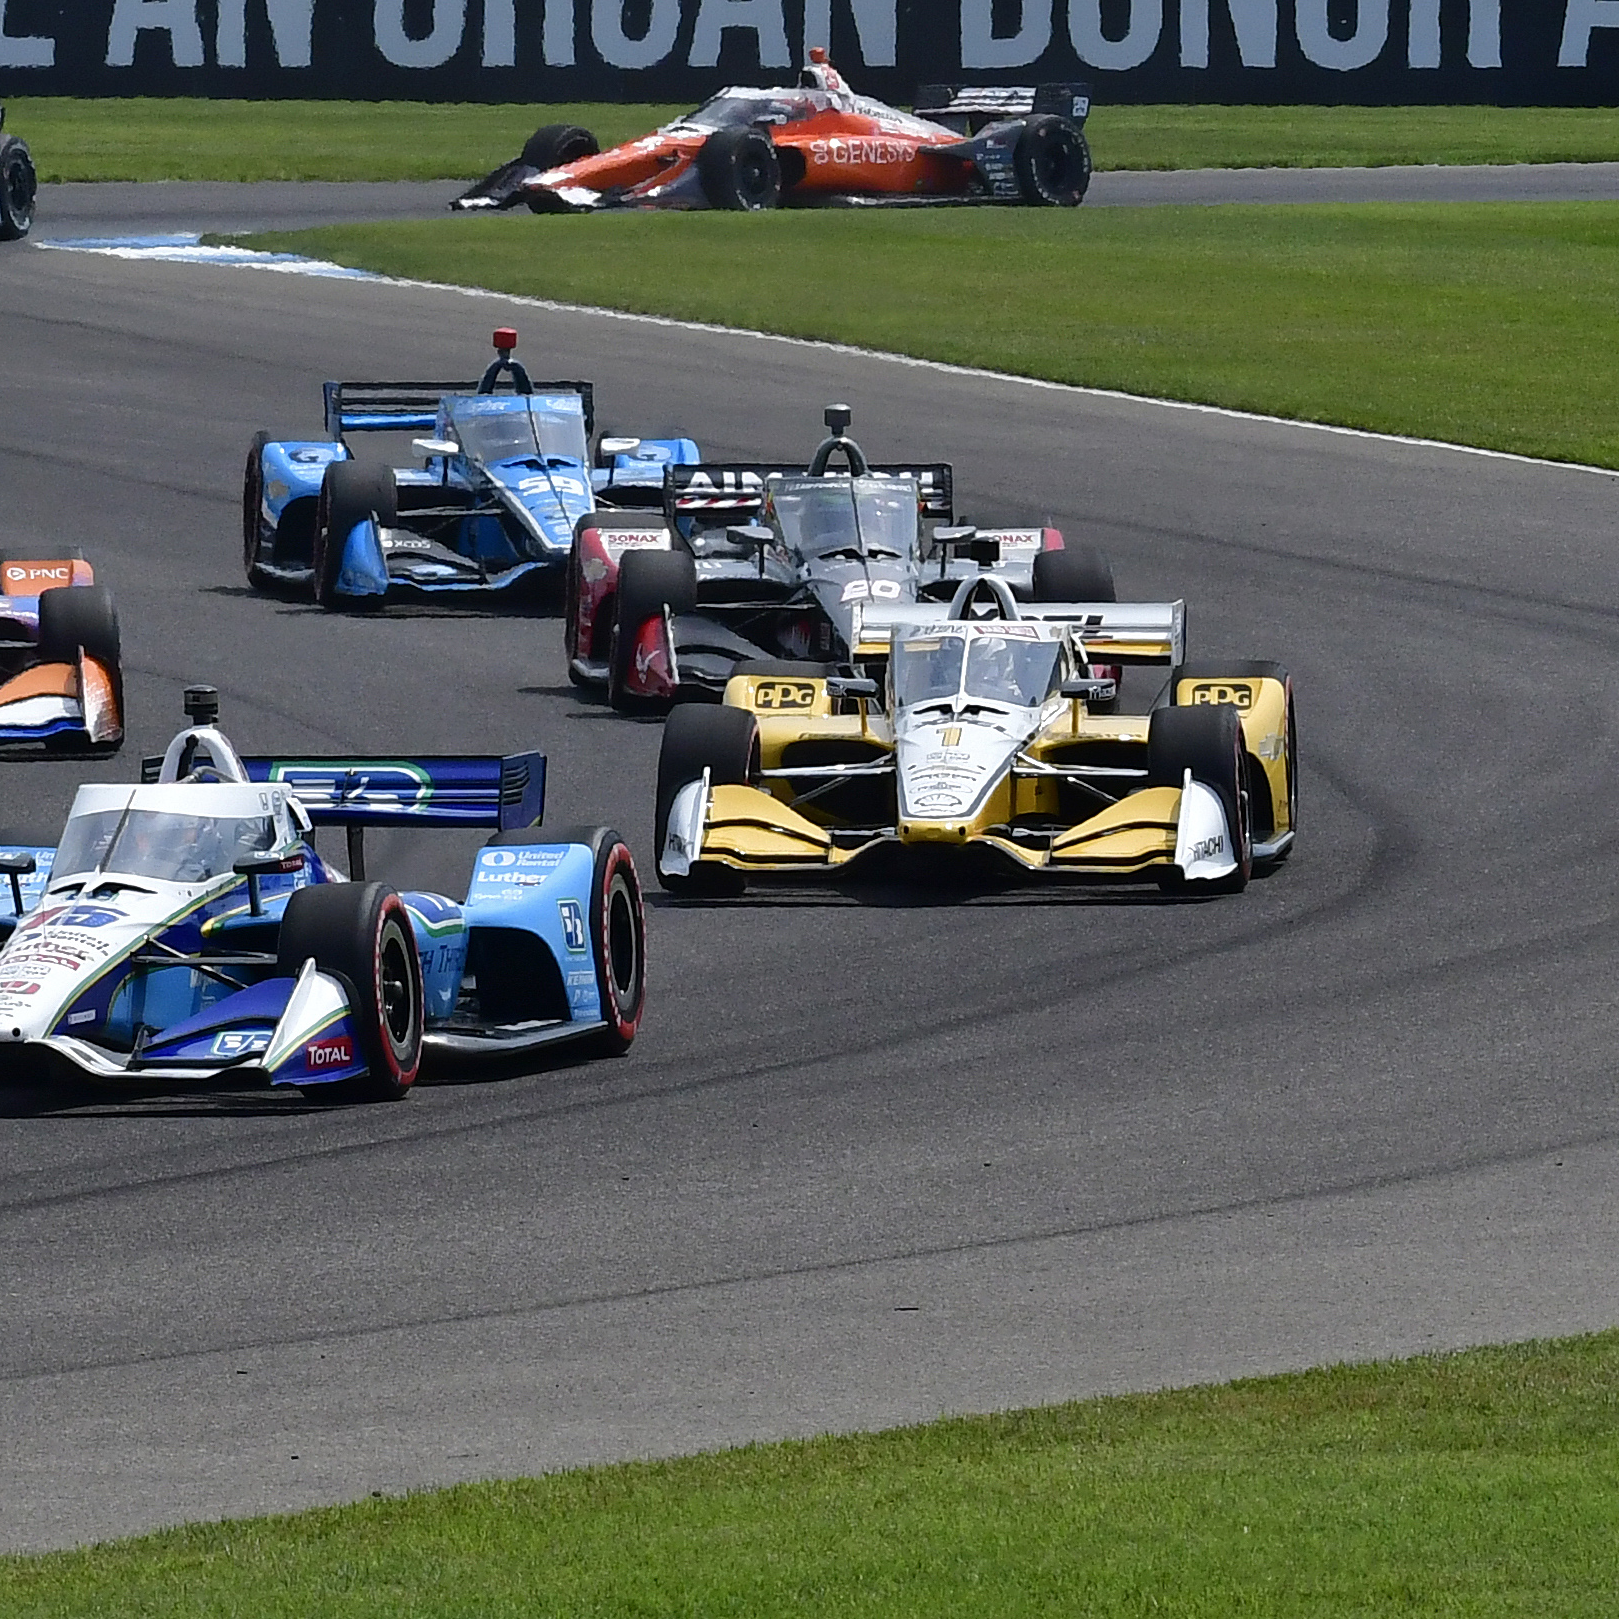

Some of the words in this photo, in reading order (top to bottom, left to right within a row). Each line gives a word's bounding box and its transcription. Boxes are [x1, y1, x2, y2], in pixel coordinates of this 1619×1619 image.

[833, 139, 915, 164] GENESYS
[608, 534, 661, 543] SONAX
[28, 568, 69, 580] PNC
[841, 580, 902, 603] 20
[757, 683, 813, 708] PPG
[1194, 686, 1250, 706] PPG
[936, 727, 962, 747] 1
[518, 851, 564, 859] United
[1193, 835, 1224, 861] HITACHI
[477, 871, 547, 882] Luther
[307, 1046, 351, 1065] TOTAL
